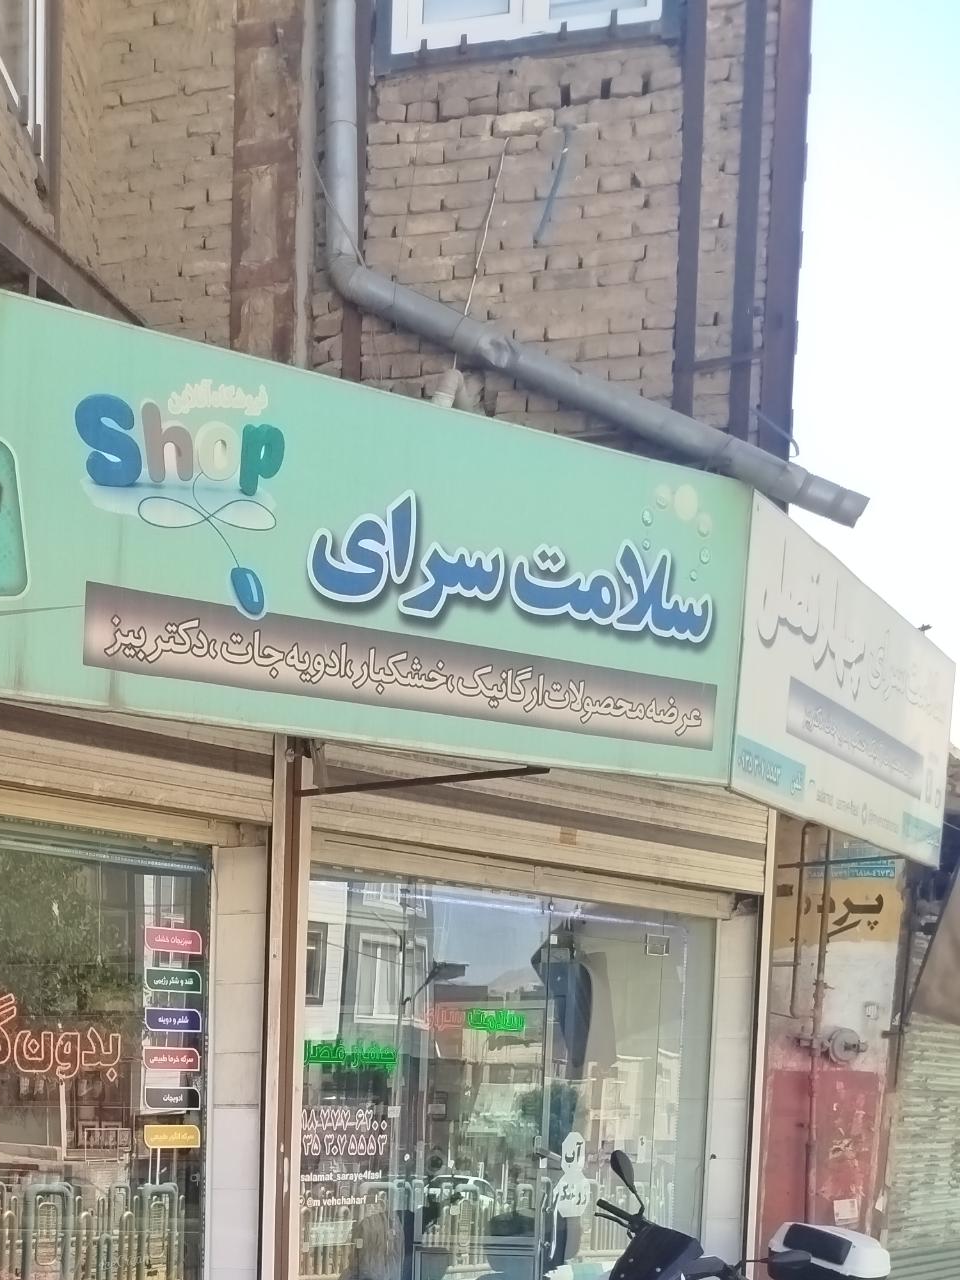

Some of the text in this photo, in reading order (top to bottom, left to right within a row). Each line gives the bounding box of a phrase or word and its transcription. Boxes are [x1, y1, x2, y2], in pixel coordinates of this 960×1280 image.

[74, 392, 286, 498] Shop
[307, 490, 713, 644] سلامت سرای
[104, 615, 147, 662] بیز
[221, 630, 285, 679] جات
[457, 665, 545, 713] ارگانیک
[543, 680, 645, 724] محصولات
[646, 697, 703, 736] عرضه
[153, 976, 168, 985] رژیمی
[169, 976, 179, 985] شکر
[13, 1026, 123, 1082] بدون
[149, 1054, 194, 1065] سرکه خرما طبیعی
[300, 1169, 382, 1182] salamat_saraye4fasl
